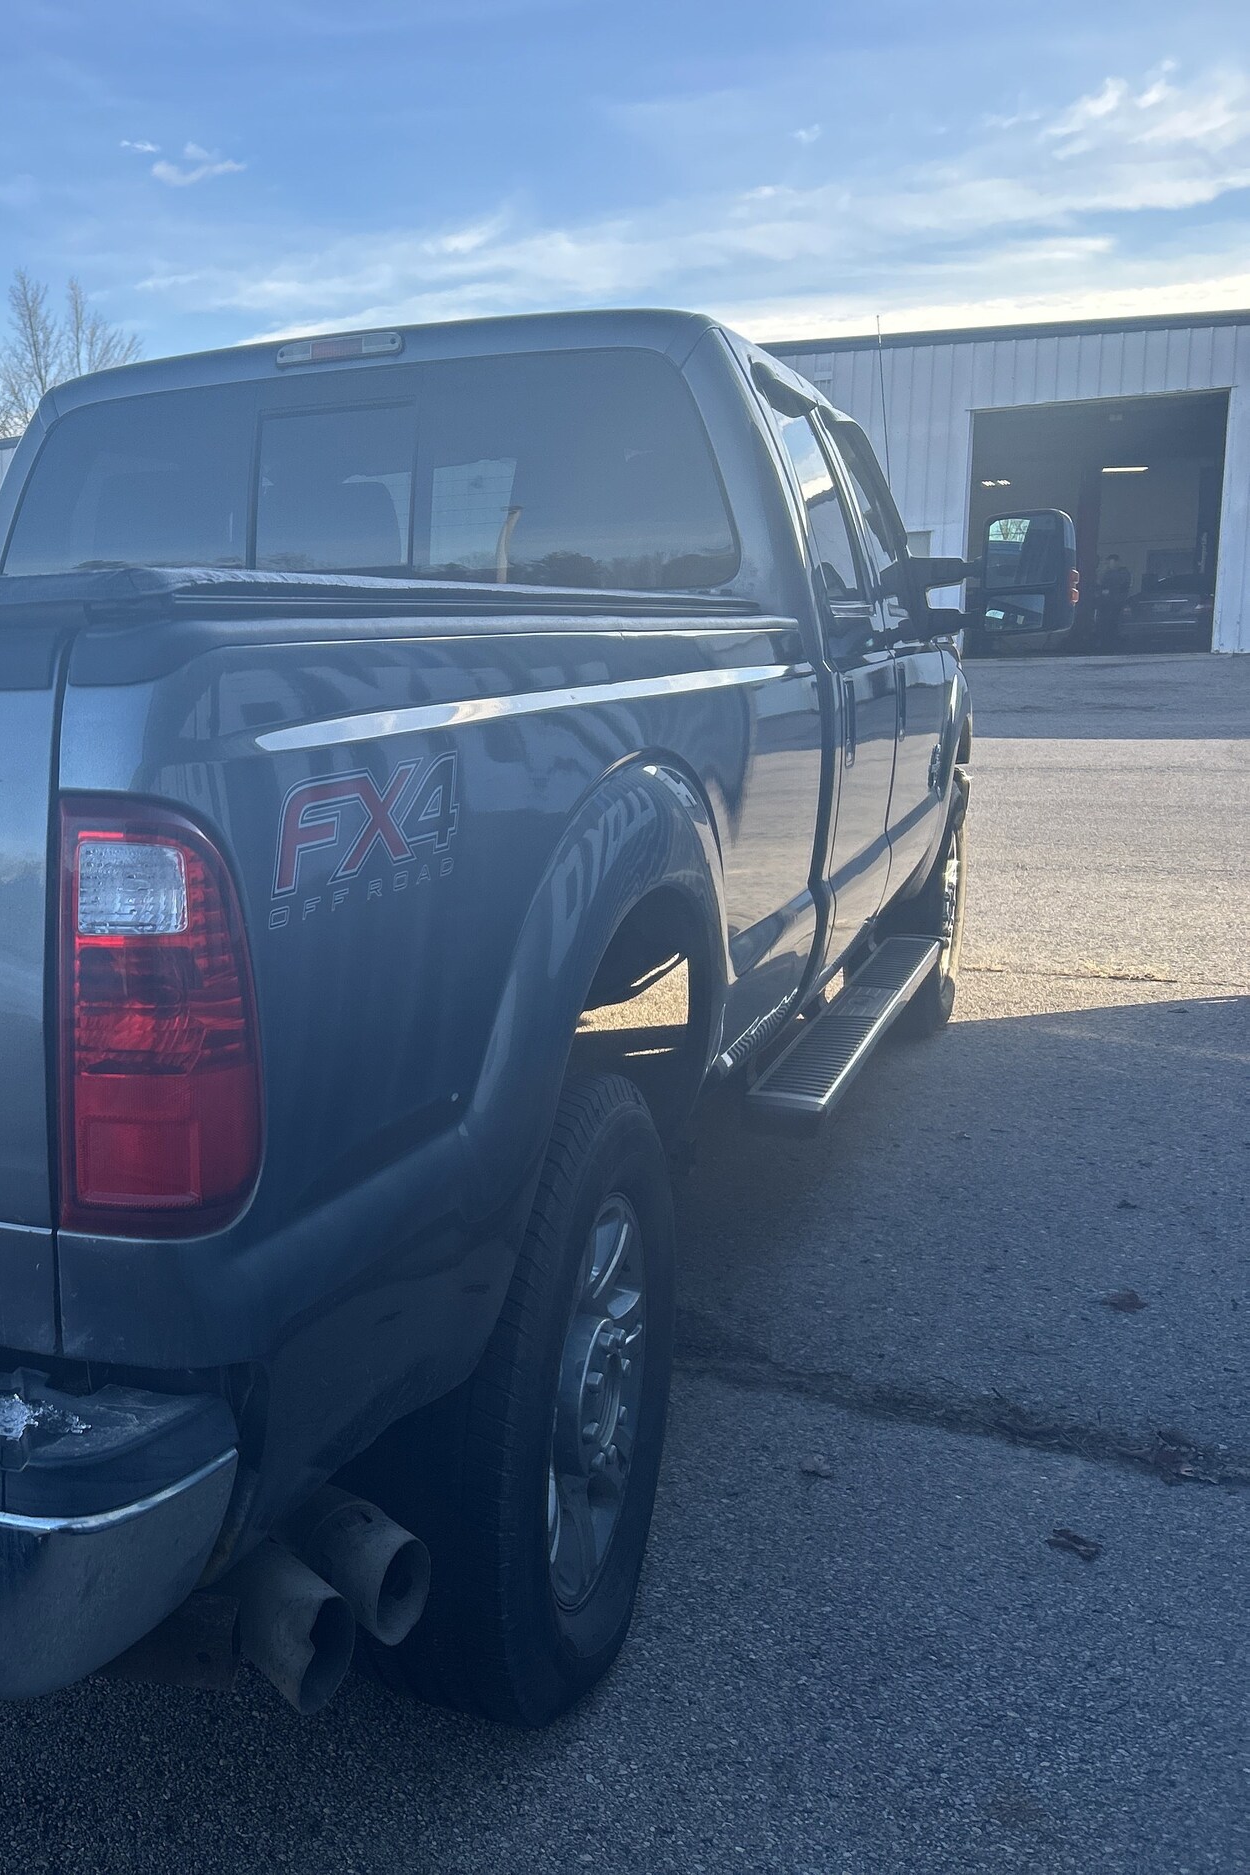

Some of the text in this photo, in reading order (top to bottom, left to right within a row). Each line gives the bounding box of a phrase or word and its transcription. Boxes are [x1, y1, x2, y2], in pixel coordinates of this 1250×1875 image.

[270, 750, 460, 901] FX4
[268, 856, 455, 930] OFF ROAD
